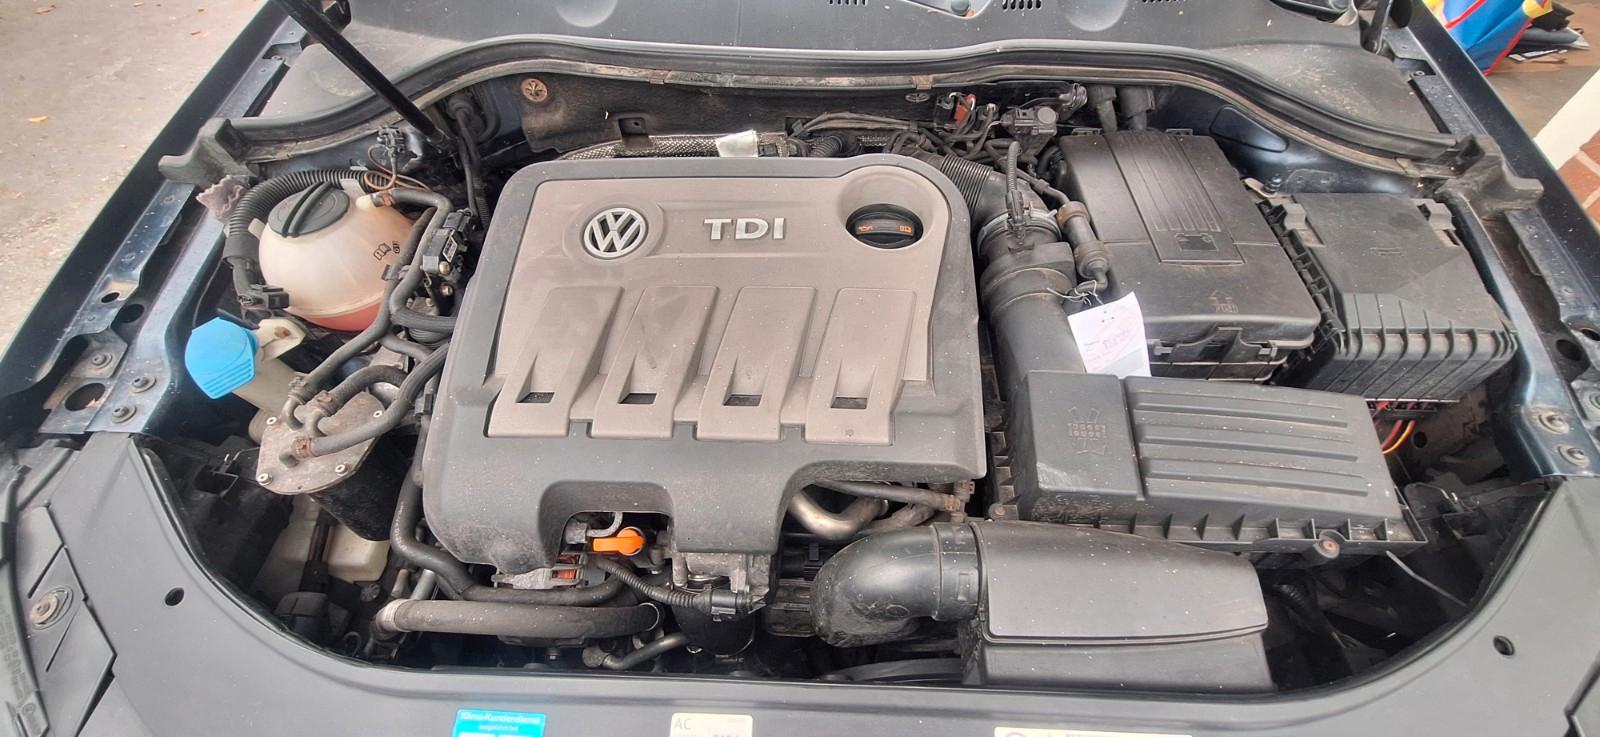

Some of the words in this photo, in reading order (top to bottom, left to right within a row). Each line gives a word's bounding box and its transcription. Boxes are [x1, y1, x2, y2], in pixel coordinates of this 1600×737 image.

[584, 207, 648, 258] VW
[703, 217, 786, 240] TDI
[673, 717, 692, 730] AC
